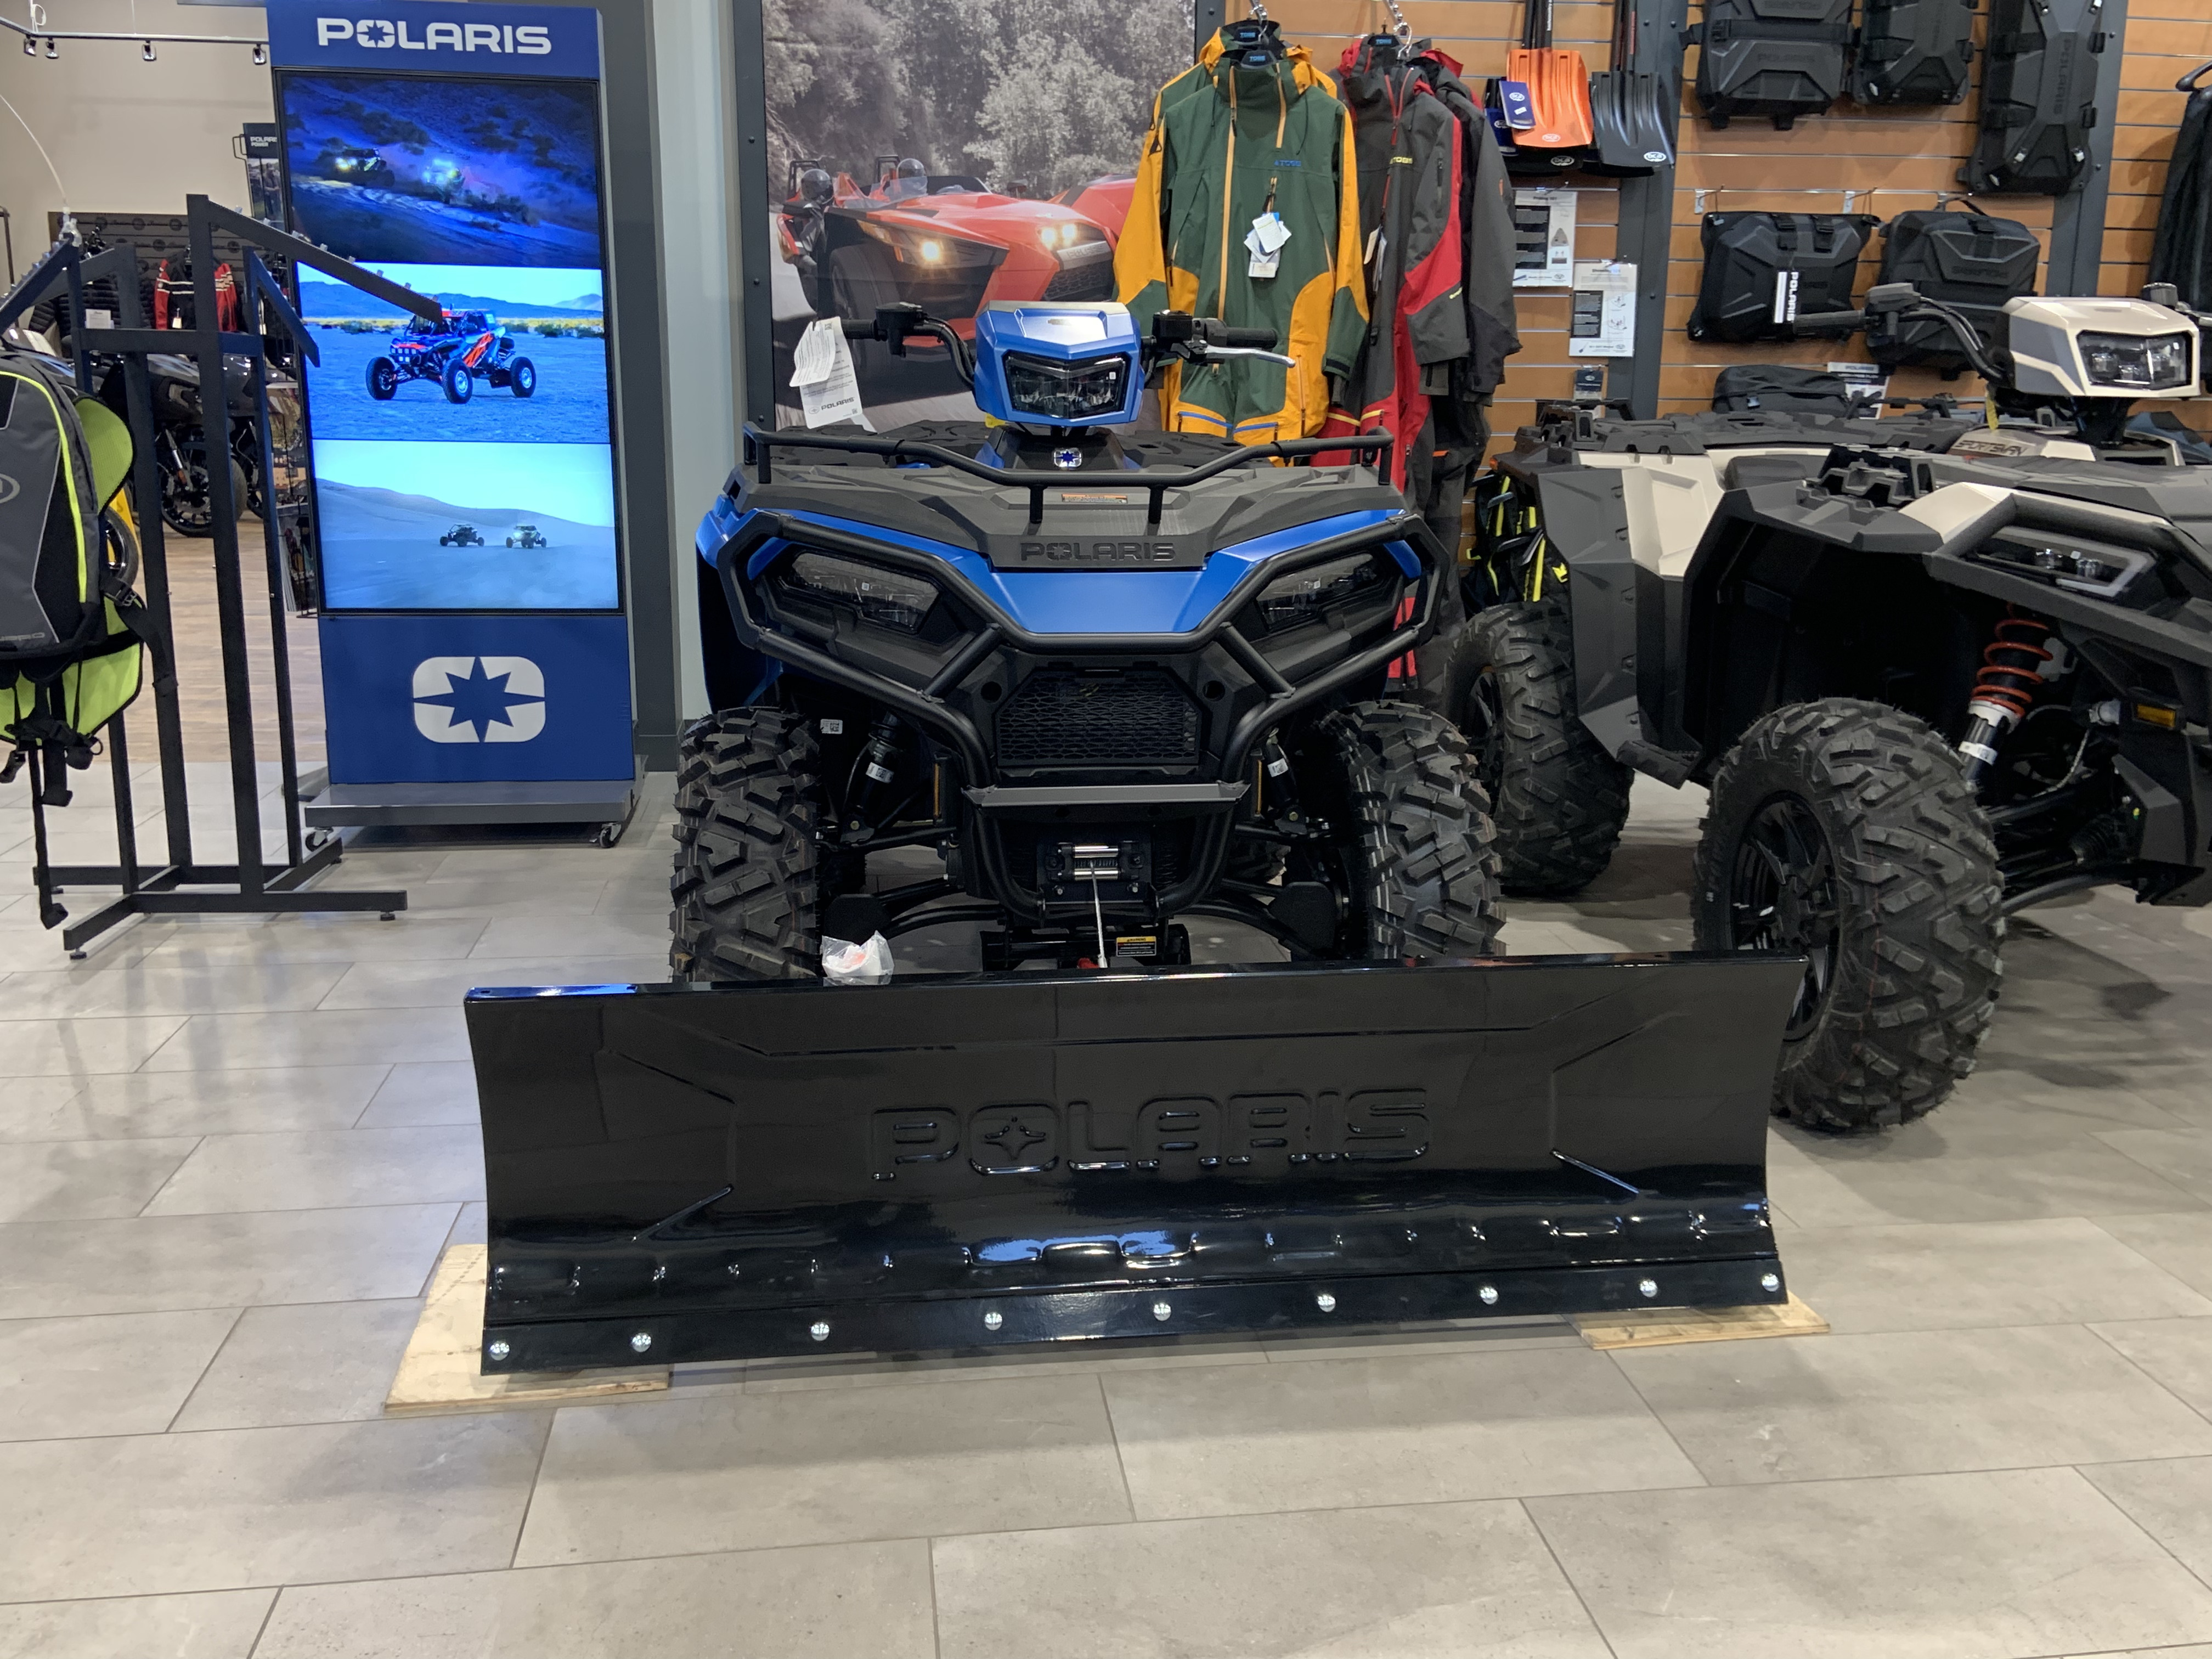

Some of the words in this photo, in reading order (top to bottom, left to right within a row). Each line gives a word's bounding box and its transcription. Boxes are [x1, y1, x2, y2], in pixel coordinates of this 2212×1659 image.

[317, 18, 552, 54] POLARIS
[1787, 272, 1799, 322] POLARIS
[821, 397, 855, 410] POLARIS
[1020, 542, 1176, 561] POLARIS
[871, 1088, 1429, 1181] POLARIS
